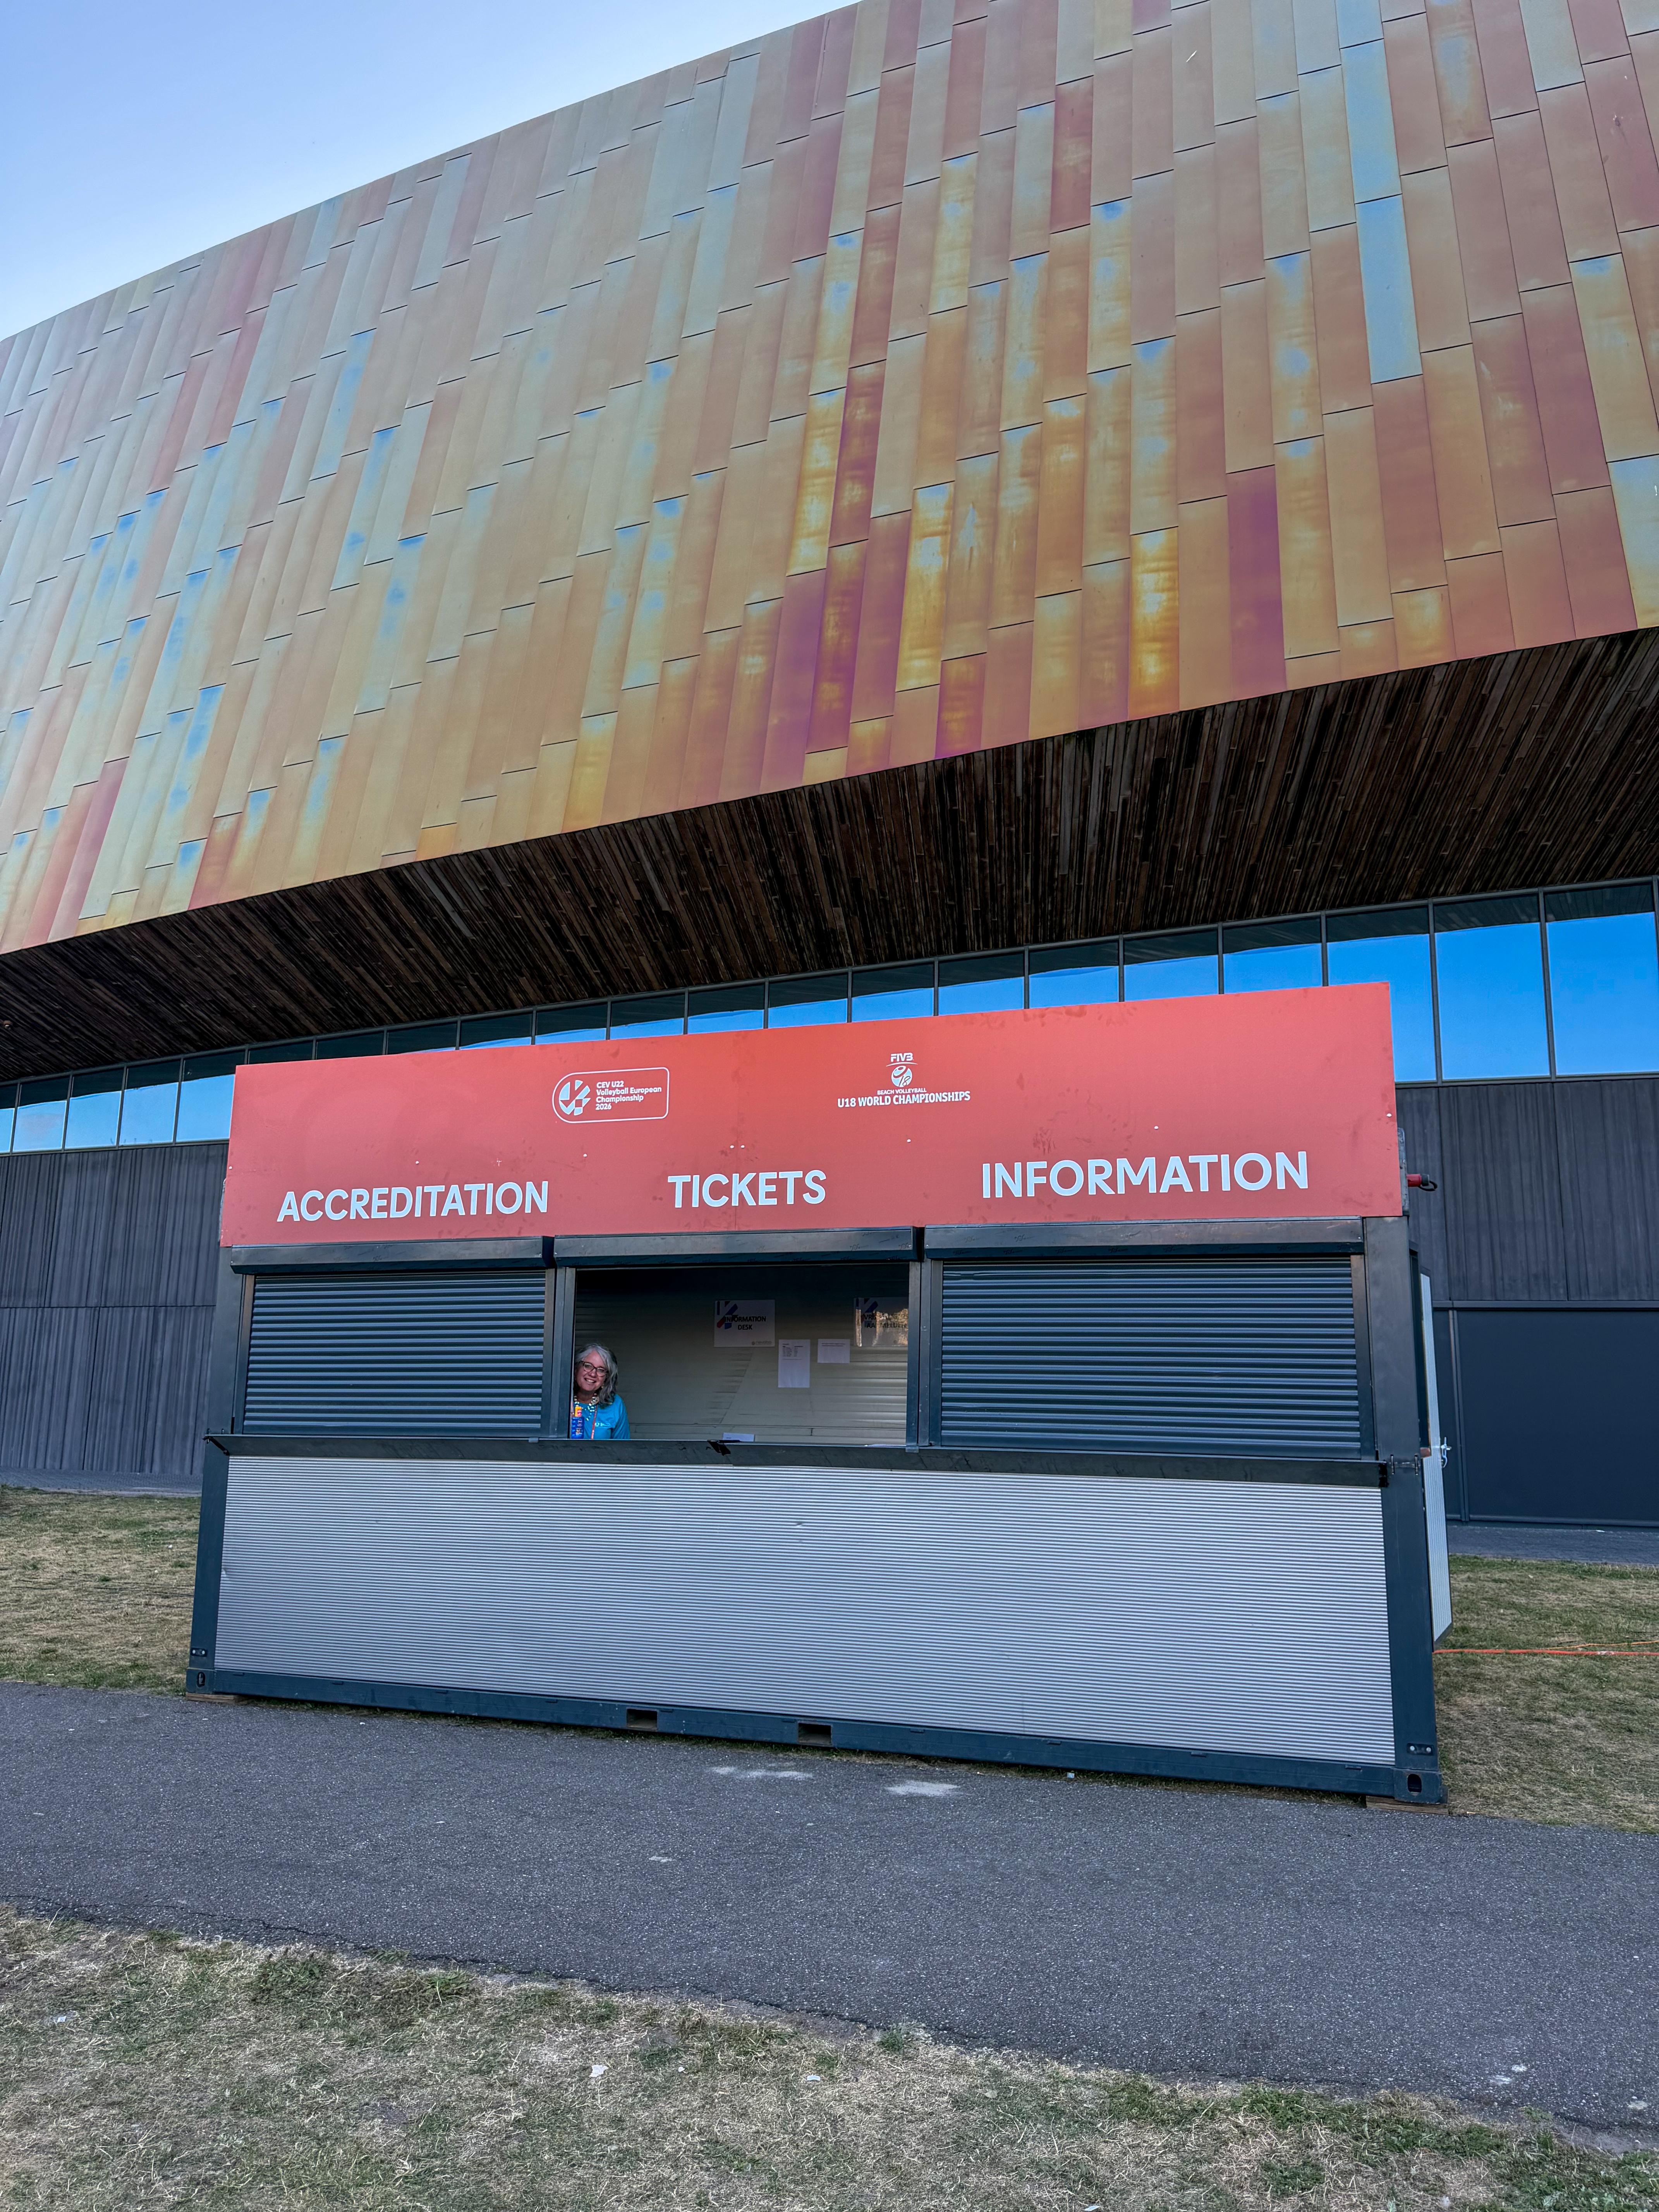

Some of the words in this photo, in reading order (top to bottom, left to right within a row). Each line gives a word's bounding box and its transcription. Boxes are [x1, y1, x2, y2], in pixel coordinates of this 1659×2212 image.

[891, 1053, 913, 1062] FIVB
[596, 1087, 629, 1096] Volleyball
[596, 1094, 644, 1103] Championship
[838, 1097, 856, 1108] U18
[858, 1096, 891, 1107] WORLD
[893, 1091, 970, 1105] CHAMPIONSHIPS
[982, 1151, 1308, 1198] INFORMATION
[668, 1170, 826, 1208] TICKETS
[276, 1181, 548, 1222] ACCREDITATION
